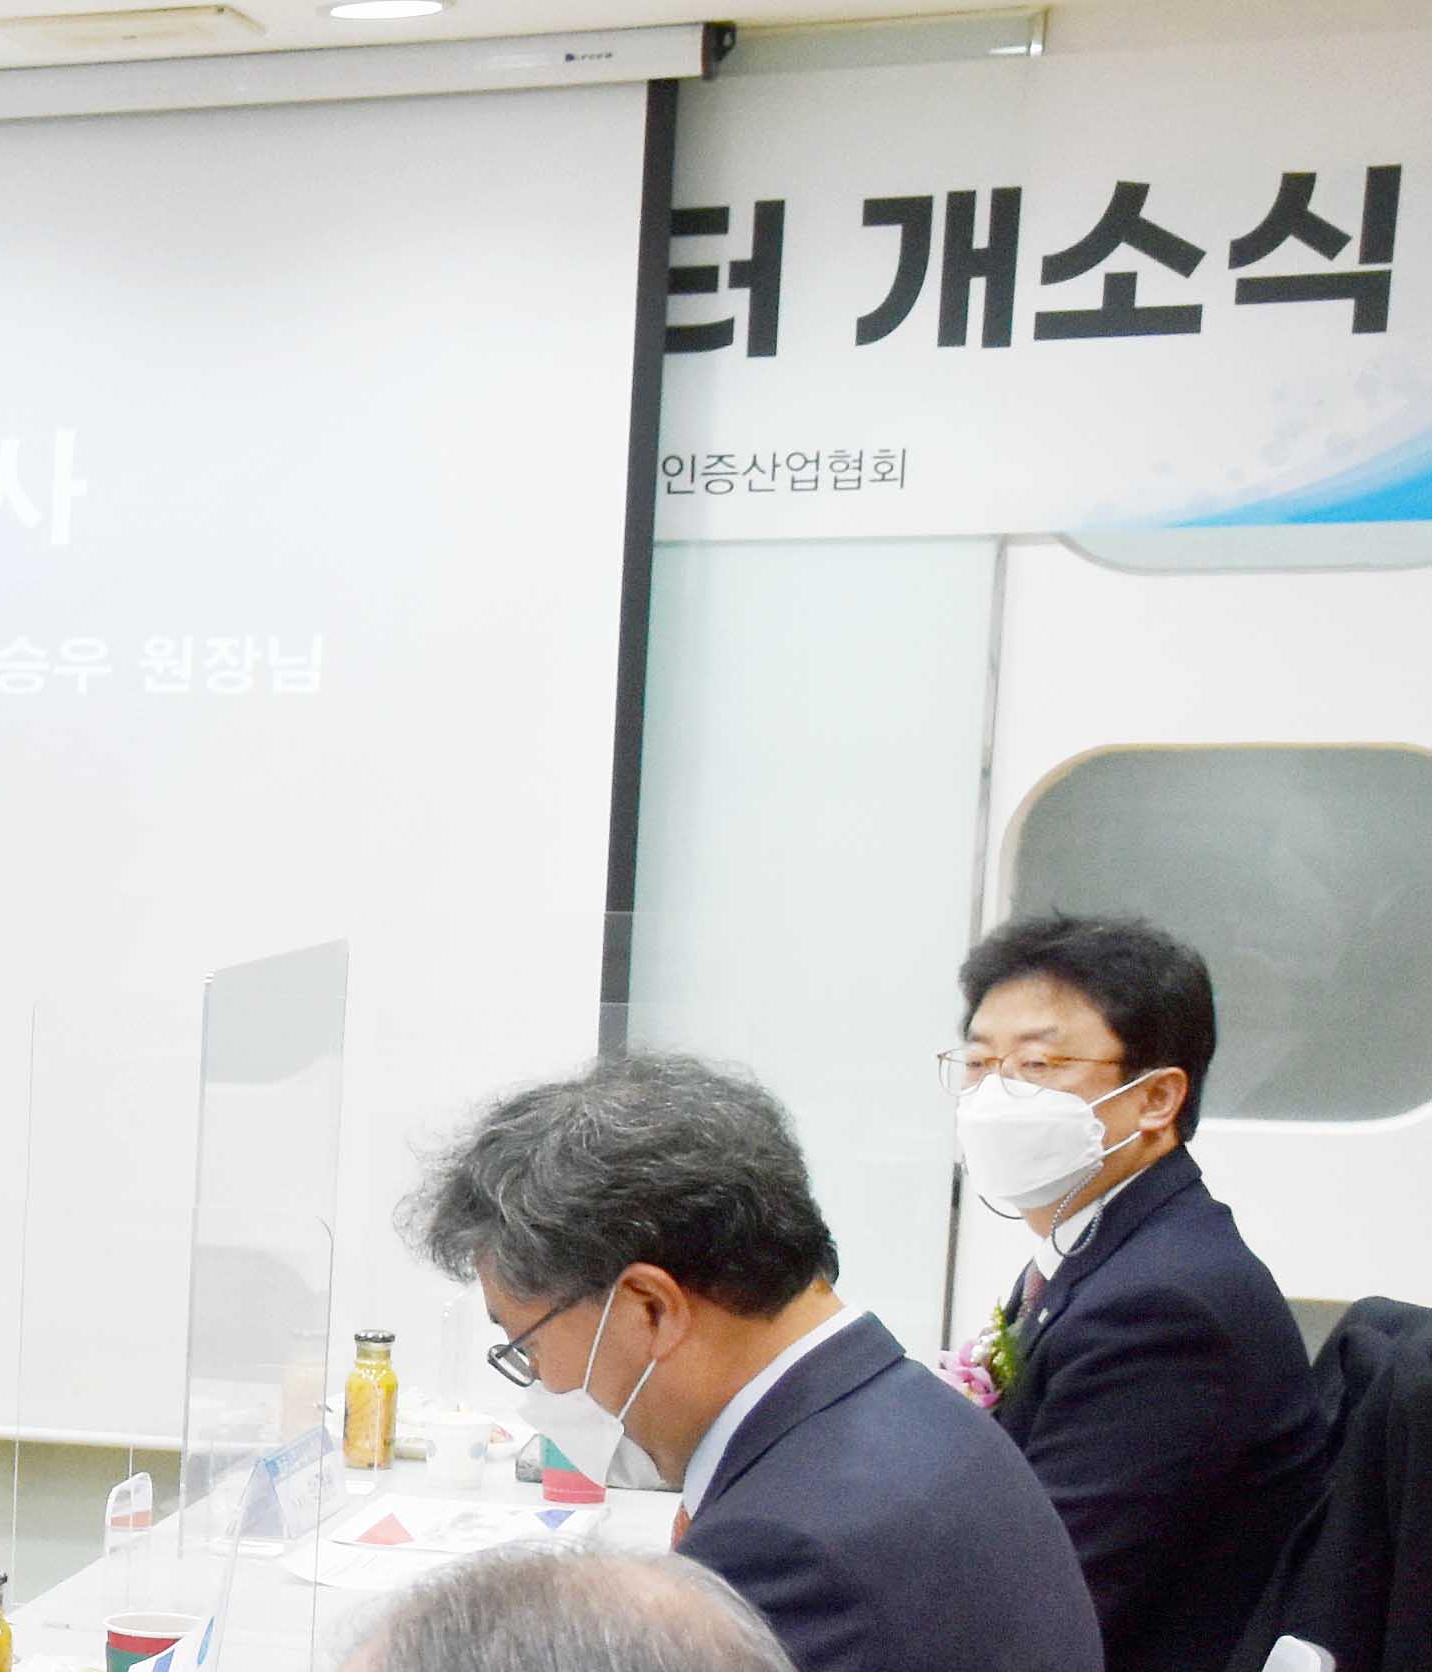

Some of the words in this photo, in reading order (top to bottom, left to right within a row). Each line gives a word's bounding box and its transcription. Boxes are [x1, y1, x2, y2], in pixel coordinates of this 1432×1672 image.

[663, 199, 786, 358] 터
[855, 164, 1403, 348] 개소식
[661, 449, 908, 495] 인증산업협회
[137, 635, 326, 695] 원장님
